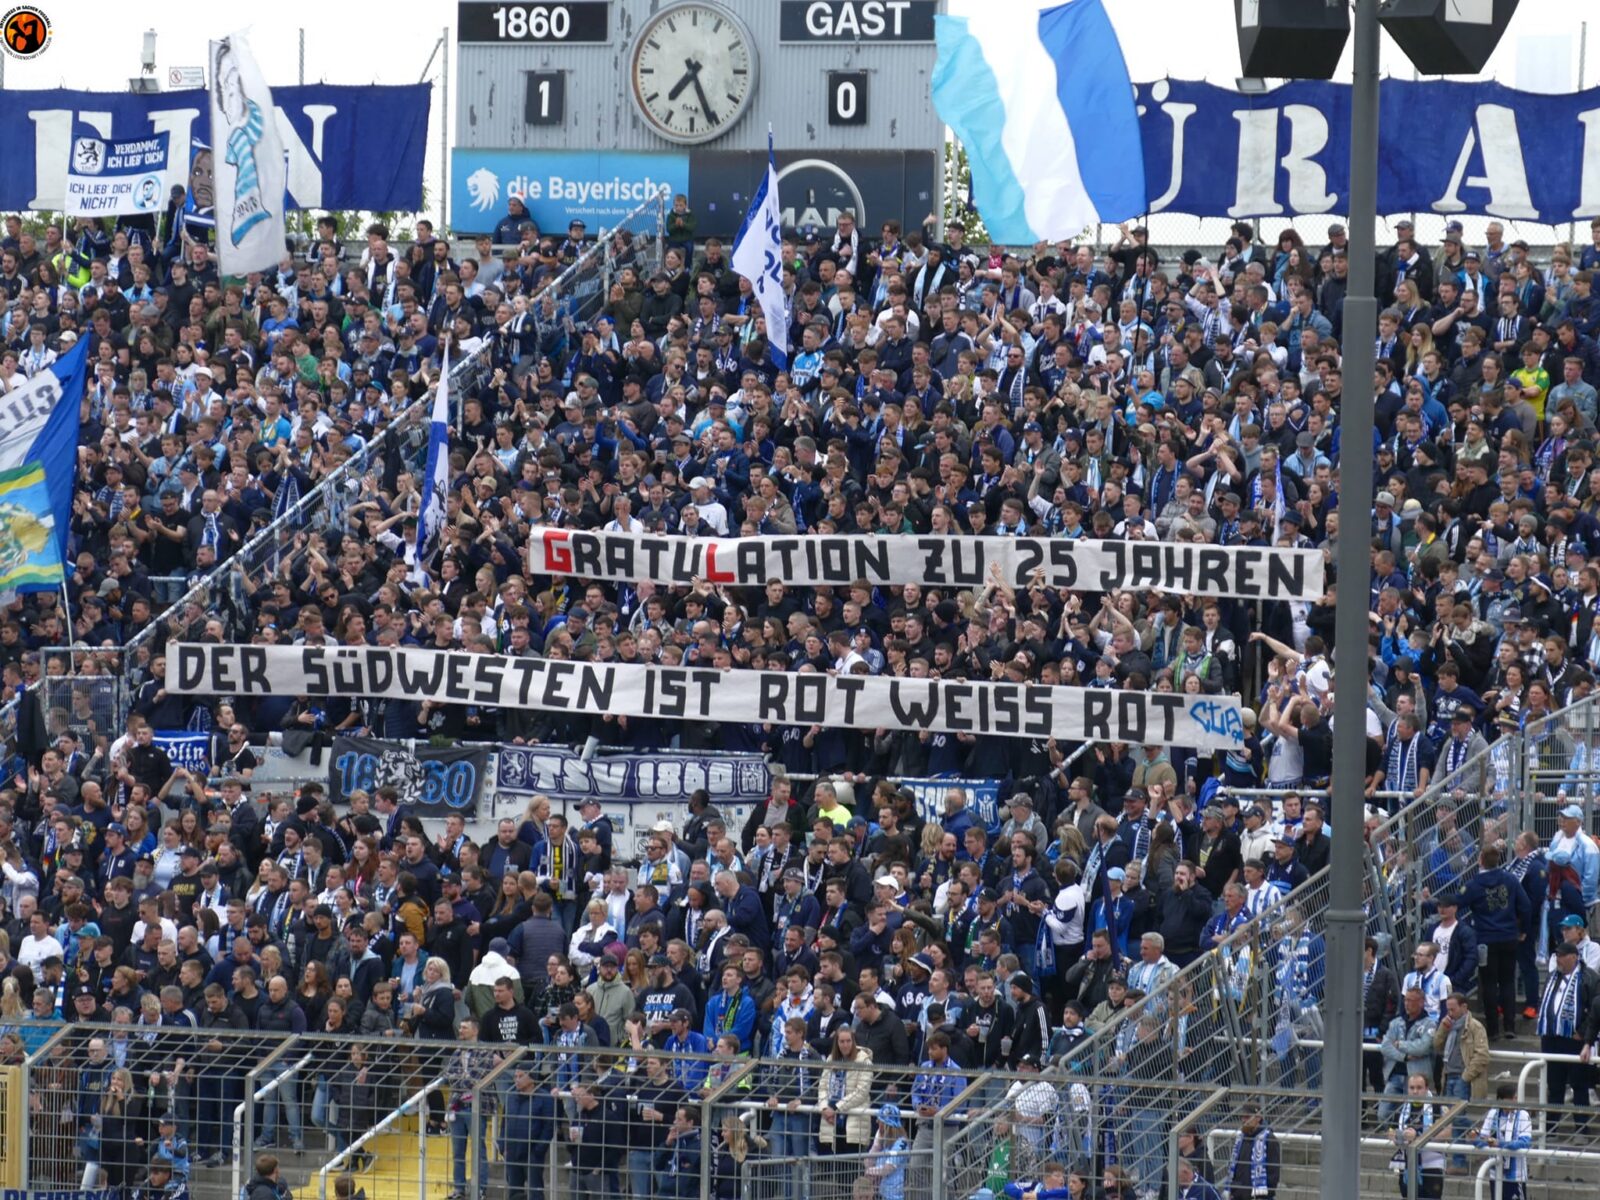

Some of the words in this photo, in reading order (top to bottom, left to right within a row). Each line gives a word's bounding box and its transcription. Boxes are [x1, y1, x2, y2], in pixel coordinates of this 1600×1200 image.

[493, 7, 571, 40] 1860
[805, 1, 910, 37] GAST
[538, 81, 551, 118] 1
[836, 81, 857, 119] 0
[107, 156, 123, 168] ICH
[69, 182, 85, 194] ICH
[112, 183, 132, 194] DICH
[80, 196, 118, 210] NICHT!
[507, 175, 542, 199] die
[550, 176, 672, 204] Bayerische
[543, 530, 889, 585] GRATULATION
[918, 538, 984, 584] ZU
[1016, 539, 1078, 587] 25
[1100, 541, 1304, 597] JAHREN
[178, 645, 273, 693] DER
[302, 648, 615, 712] SÜDWESTEN
[644, 669, 721, 717] IST
[759, 674, 866, 725] ROT
[891, 680, 1054, 736] WEISS
[1084, 690, 1185, 743] ROT
[335, 750, 378, 797] 18
[530, 754, 628, 795] TSV
[637, 761, 734, 796] 1860
[663, 994, 676, 1004] OF
[902, 991, 925, 1008] 186
